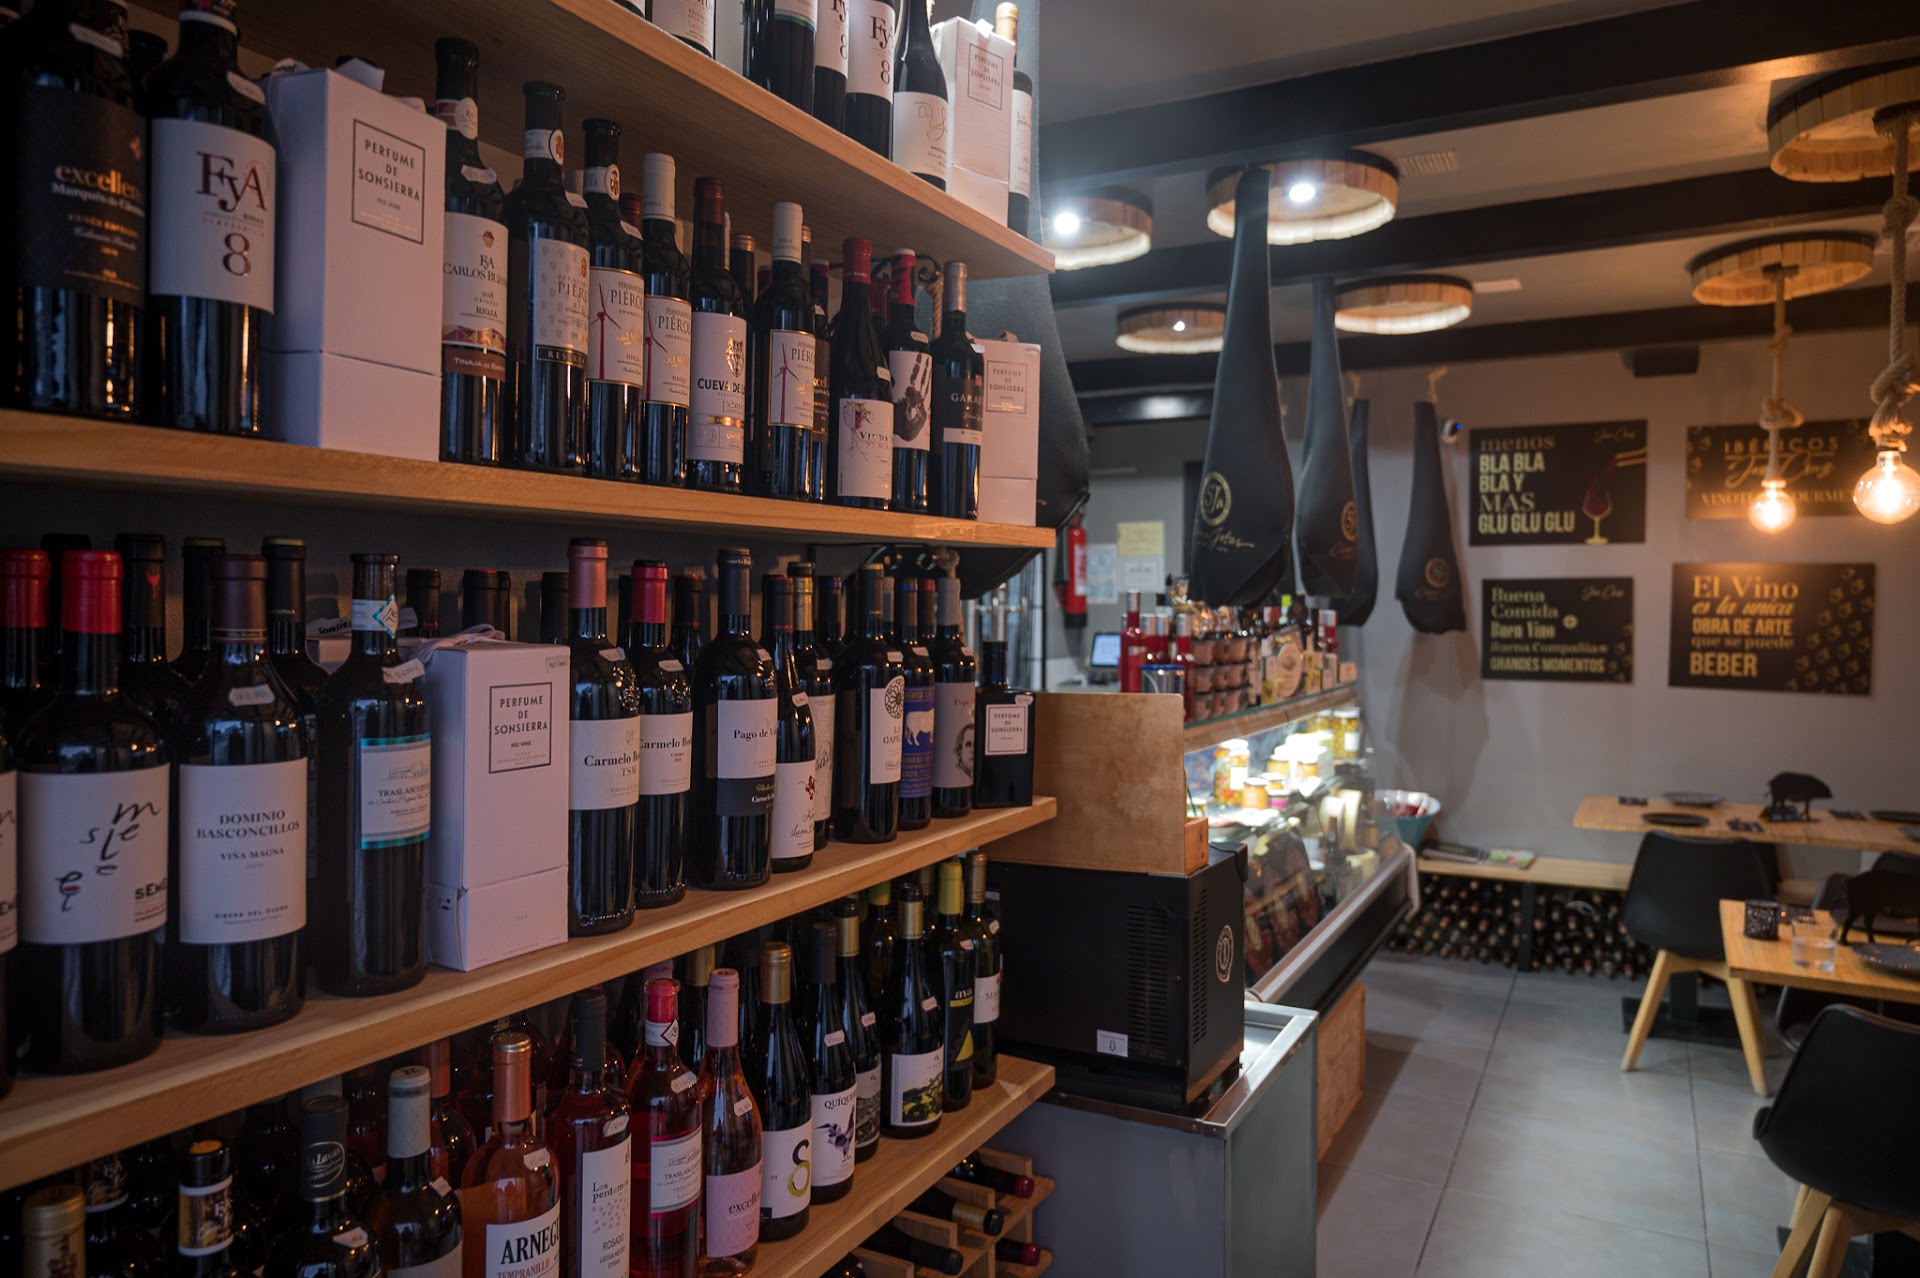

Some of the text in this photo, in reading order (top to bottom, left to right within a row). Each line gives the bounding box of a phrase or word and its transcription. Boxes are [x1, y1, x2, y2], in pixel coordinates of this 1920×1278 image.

[880, 60, 890, 85] 8
[365, 139, 415, 169] PERFUME
[386, 164, 398, 177] DE
[358, 168, 421, 201] SONSIERRA
[223, 233, 251, 277] 8
[476, 307, 498, 318] RIOJA
[454, 356, 482, 367] TINAJA
[697, 377, 733, 393] CUEVA
[732, 382, 741, 393] DE
[989, 384, 1024, 393] SONSIERRA
[1479, 451, 1545, 473] BLA BLA
[1479, 472, 1526, 493] BLA Y
[1477, 509, 1576, 535] GLU GLU GLU
[1491, 586, 1546, 603] Buena
[1693, 575, 1800, 600] El Vino
[1491, 602, 1559, 619] Comida
[1490, 620, 1557, 639] Buen Vino
[1691, 617, 1793, 636] OBRA DE ARTE
[1691, 636, 1722, 650] que
[1744, 635, 1795, 651] puede
[1489, 656, 1606, 673] GRANDES MOMENTOS
[1689, 651, 1758, 678] BEBER
[500, 695, 543, 708] PERFUME
[518, 710, 529, 719] DE
[494, 721, 548, 735] SONSIERRA
[734, 728, 768, 742] Pago de
[584, 753, 632, 767] Carmelo
[220, 809, 285, 825] DOMINIO
[196, 820, 300, 839] BASCONCILLOS
[250, 847, 285, 858] MAGNA
